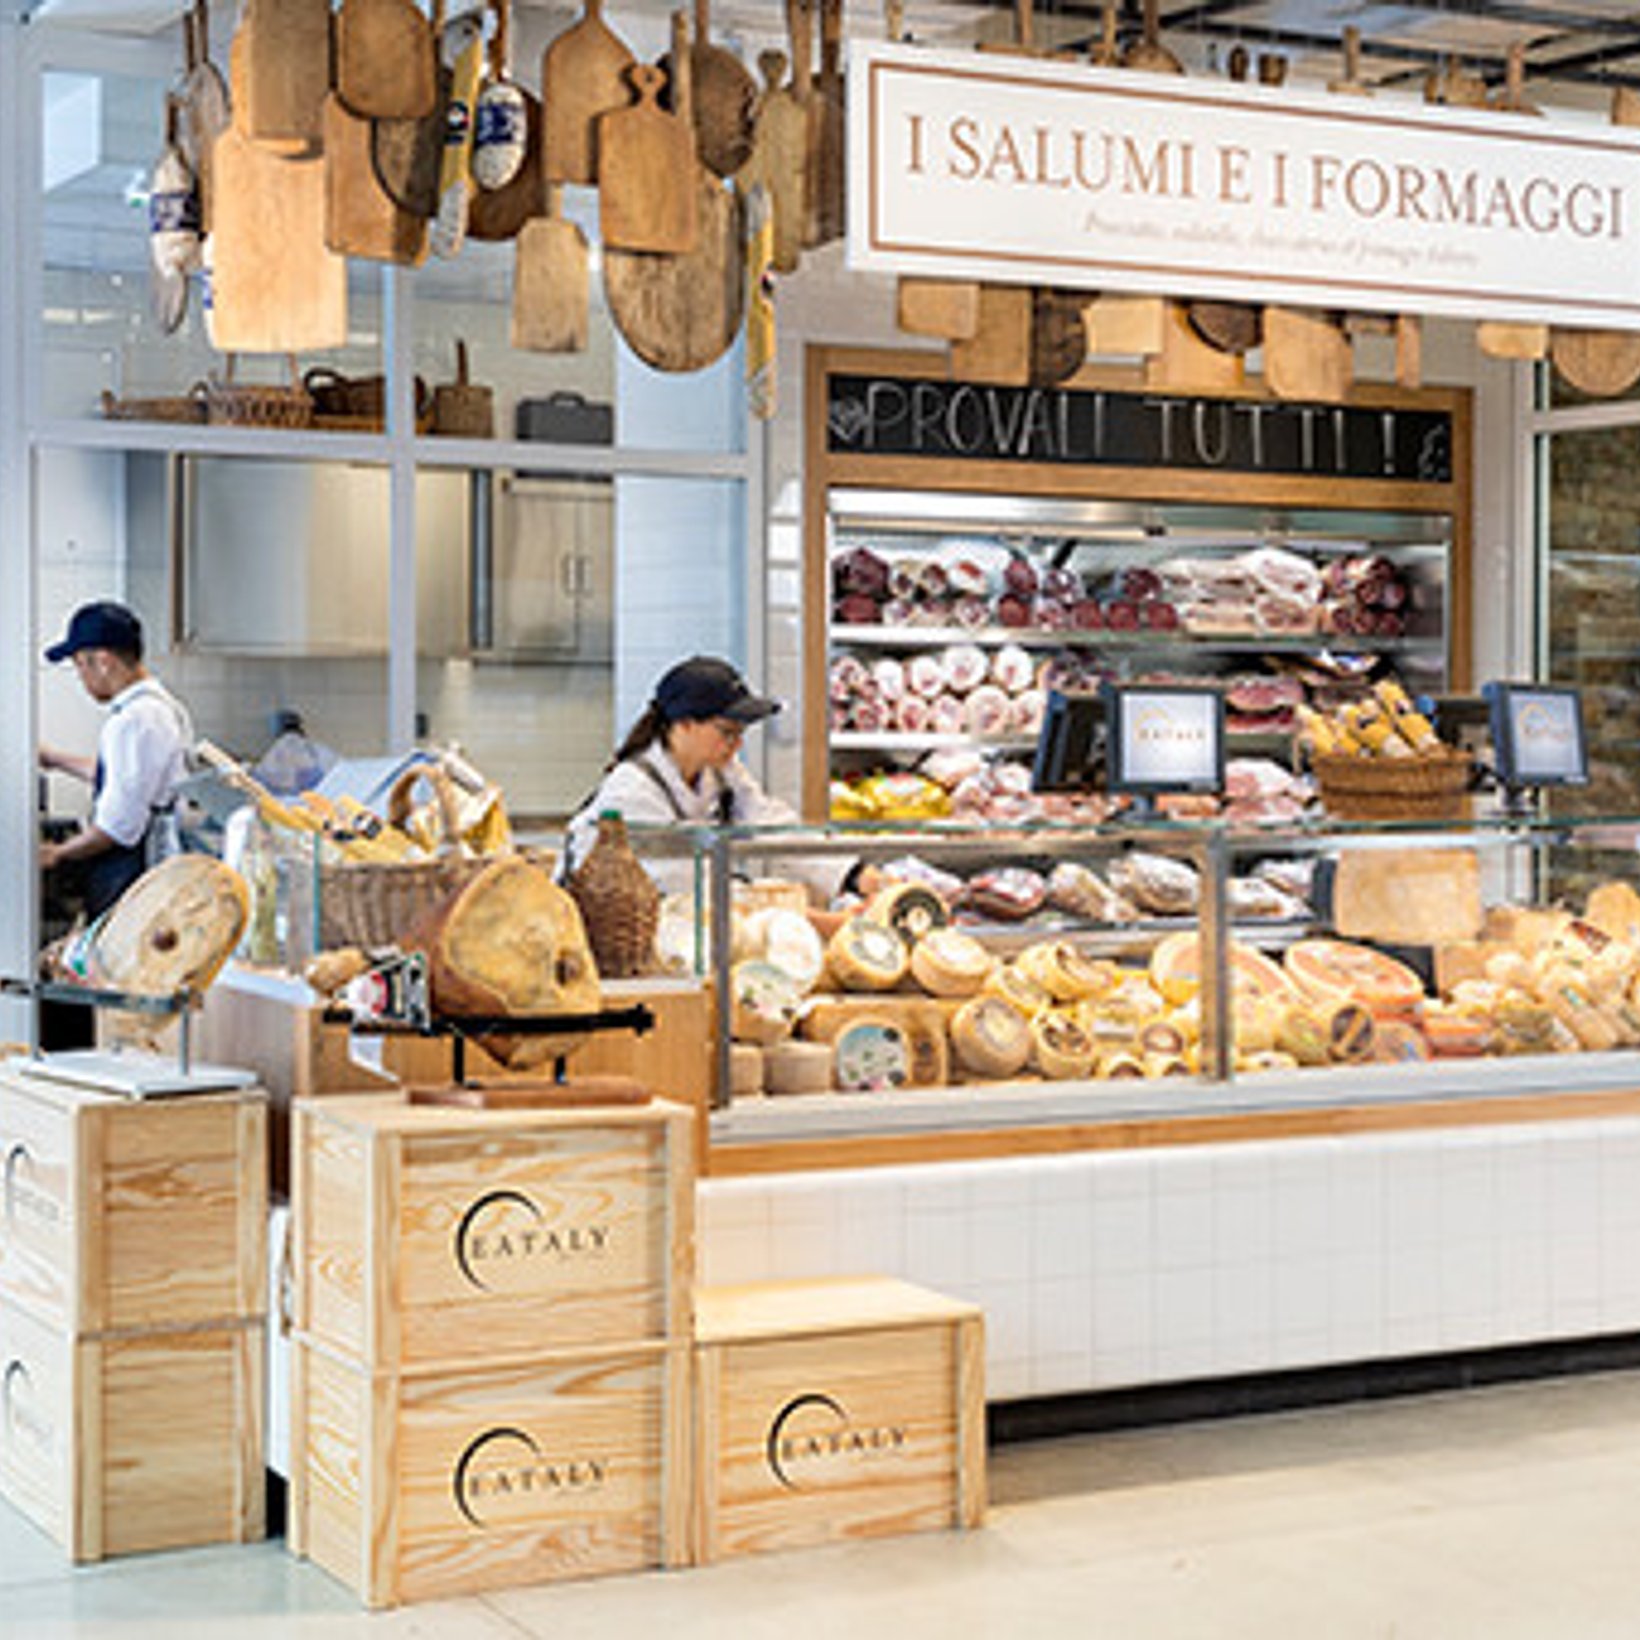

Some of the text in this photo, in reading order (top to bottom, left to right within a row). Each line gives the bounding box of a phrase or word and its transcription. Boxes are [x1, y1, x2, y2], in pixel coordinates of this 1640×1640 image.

[906, 115, 924, 175] I
[949, 118, 1195, 199] SALUMI
[1217, 148, 1253, 205] E
[1272, 152, 1290, 208] I
[1310, 155, 1624, 239] FORMAGGI
[471, 1225, 610, 1260] EATALY
[781, 1426, 907, 1461] EATALY
[469, 1457, 610, 1496] EATALY
